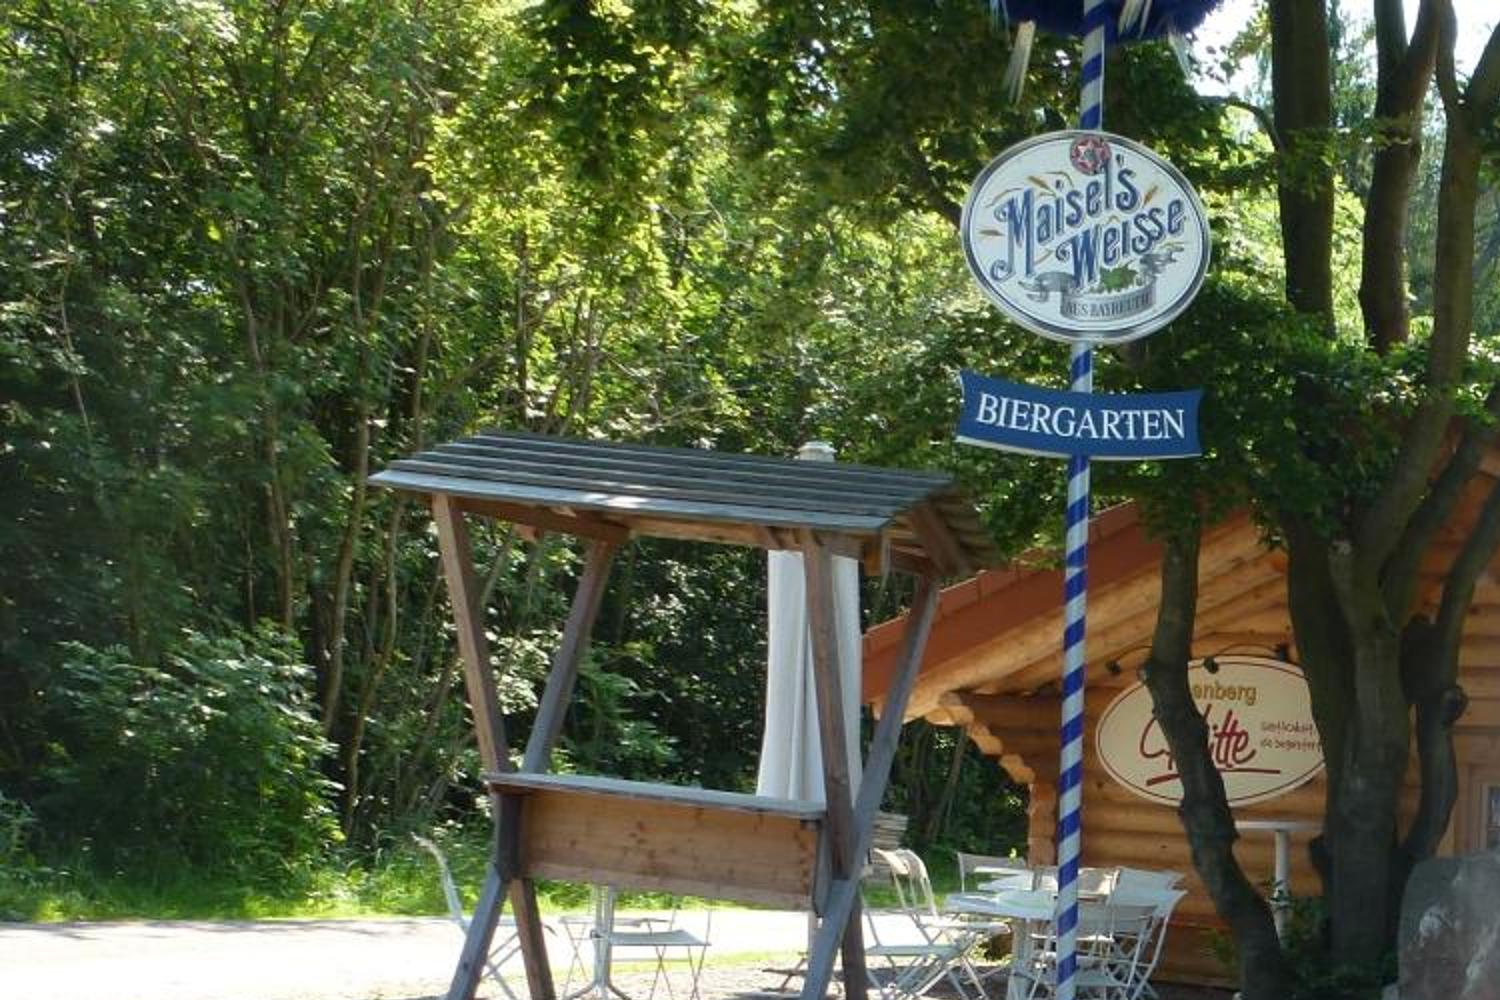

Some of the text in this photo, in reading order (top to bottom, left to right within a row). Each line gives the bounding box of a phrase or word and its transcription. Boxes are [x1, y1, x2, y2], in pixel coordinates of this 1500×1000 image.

[990, 153, 1139, 281] Maisel's
[1056, 198, 1187, 288] Weisse
[976, 392, 1185, 440] BIERGARTEN
[1193, 682, 1257, 706] enberg
